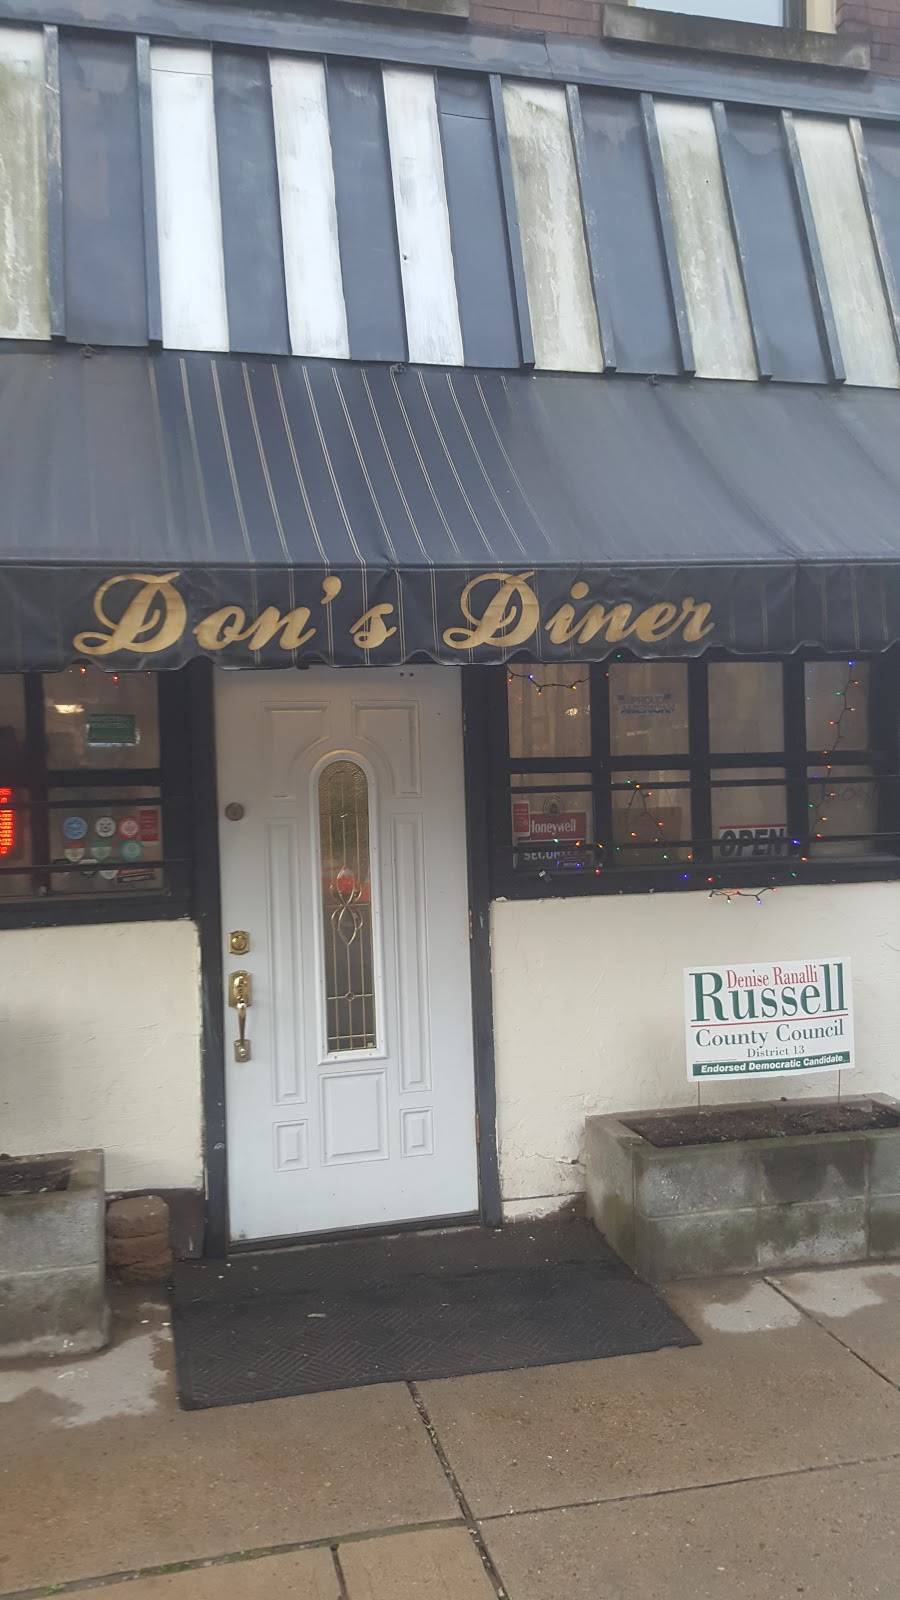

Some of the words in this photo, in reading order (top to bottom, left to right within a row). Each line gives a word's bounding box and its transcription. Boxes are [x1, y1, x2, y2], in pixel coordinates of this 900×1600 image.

[73, 571, 397, 655] Don's
[442, 570, 715, 650] Diner
[720, 829, 785, 857] OPEN
[726, 969, 769, 989] Denise
[772, 964, 818, 986] Ranalli
[689, 962, 848, 1022] Russell
[695, 1028, 769, 1049] County
[776, 1018, 844, 1042] Council
[701, 1062, 746, 1073] Endorsed
[748, 1057, 801, 1070] Democratic
[803, 1054, 844, 1067] Candidate
[747, 1046, 789, 1058] District
[793, 1045, 805, 1055] 13
